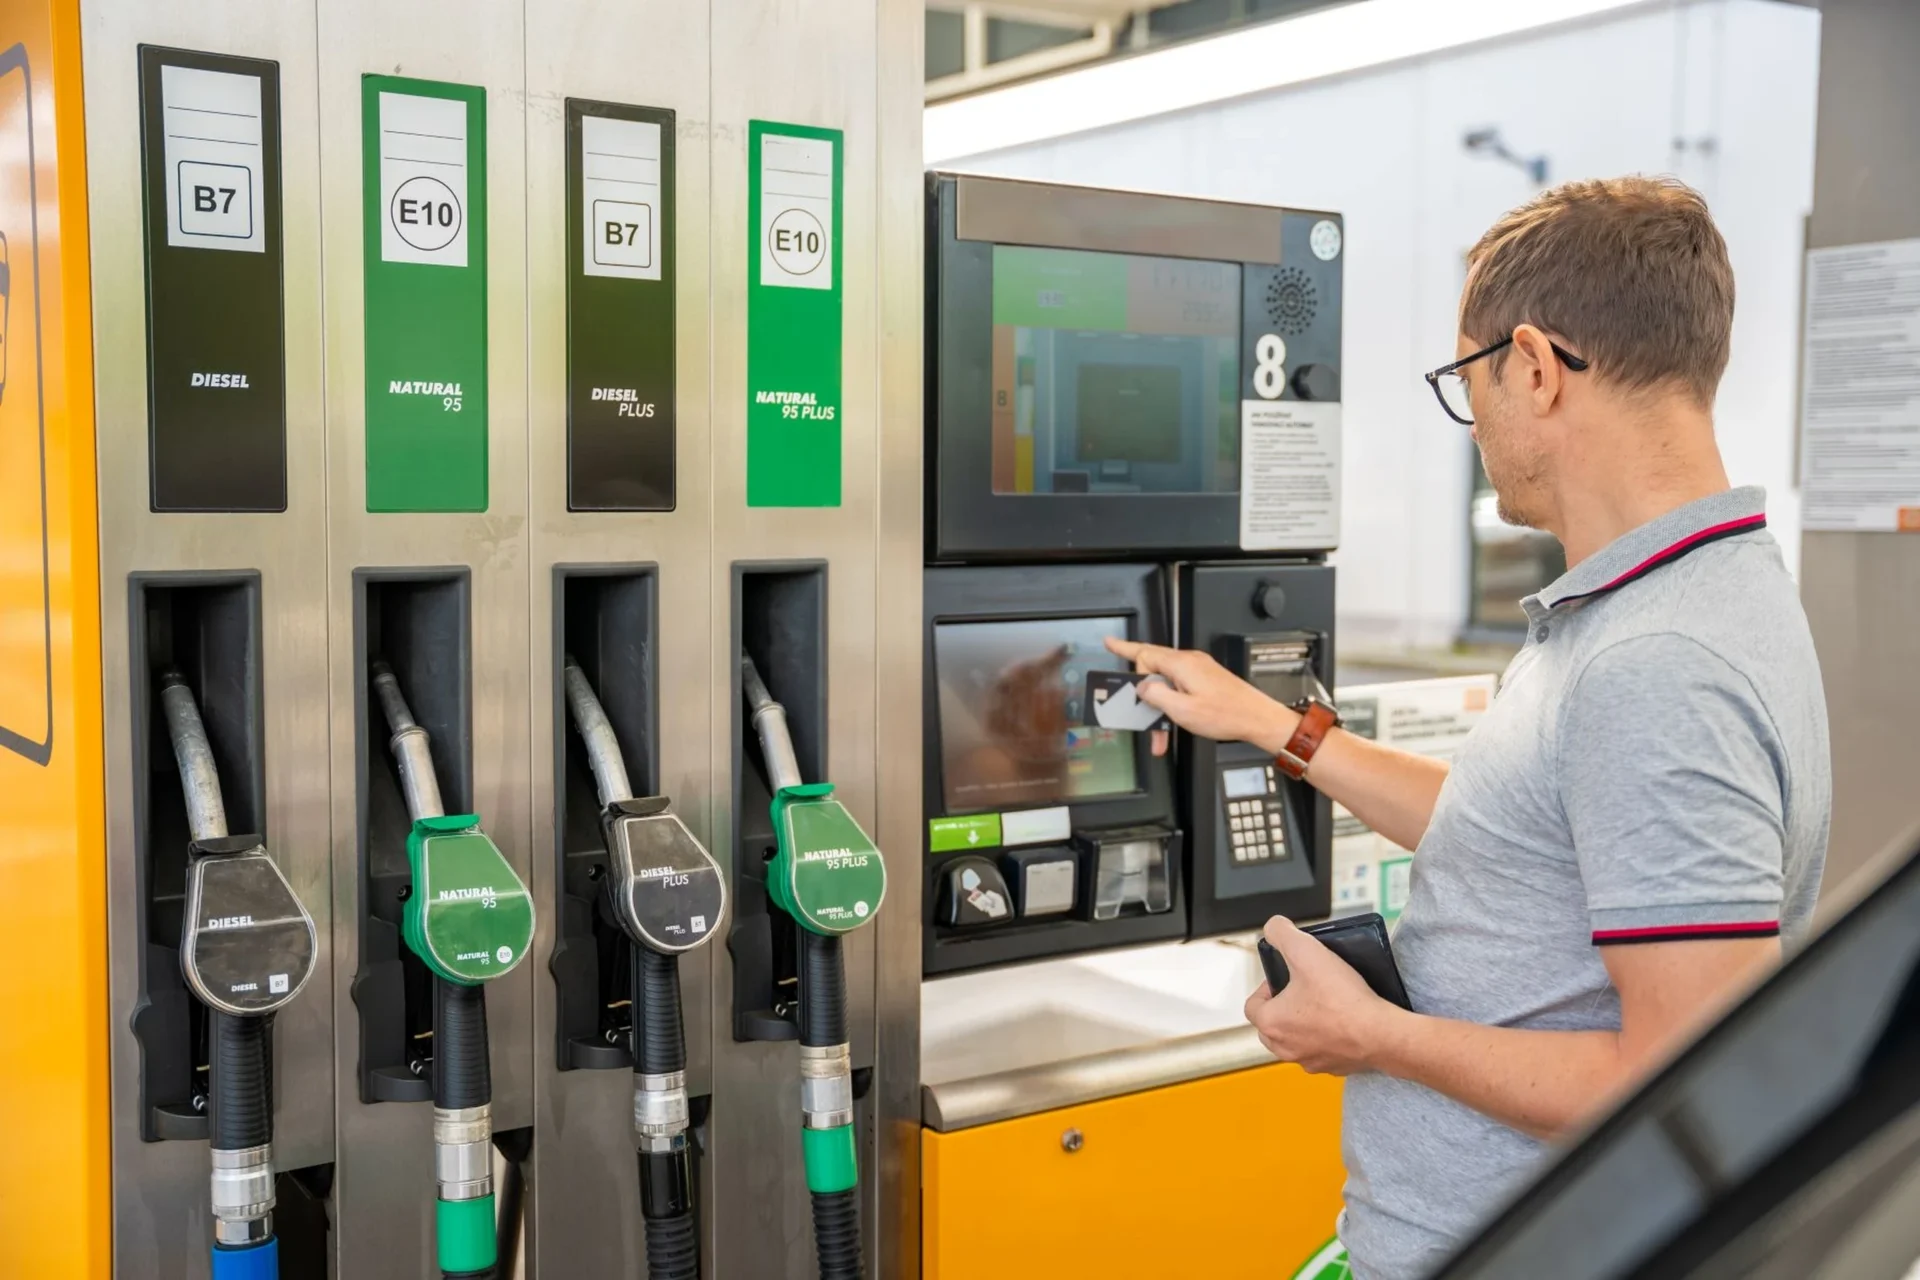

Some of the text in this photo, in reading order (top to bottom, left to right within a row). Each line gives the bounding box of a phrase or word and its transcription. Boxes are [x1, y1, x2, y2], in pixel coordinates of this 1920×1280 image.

[193, 184, 237, 215] B7
[399, 198, 453, 228] E10
[605, 221, 640, 247] B7
[775, 229, 820, 254] E10
[1253, 333, 1287, 400] 8
[190, 372, 250, 389] DIESEL
[389, 380, 463, 396] NATURAL
[591, 387, 639, 402] DIESEL
[755, 390, 818, 406] NATURAL
[443, 396, 463, 412] 95
[618, 402, 655, 418] PLUS
[782, 404, 836, 420] 95 PLUS
[803, 847, 853, 861] NATURAL
[826, 855, 869, 870] 95 PLUS
[640, 865, 676, 879] DIESEL
[662, 873, 690, 889] PLUS
[439, 885, 497, 901] NATURAL
[481, 897, 497, 909] 95
[816, 906, 845, 916] NATURAL
[208, 914, 256, 930] DIESEL
[828, 910, 854, 921] 95 PLUS
[456, 950, 490, 961] NATURAL
[480, 958, 491, 966] 95
[230, 982, 258, 993] DIESEL
[274, 979, 285, 989] B7
